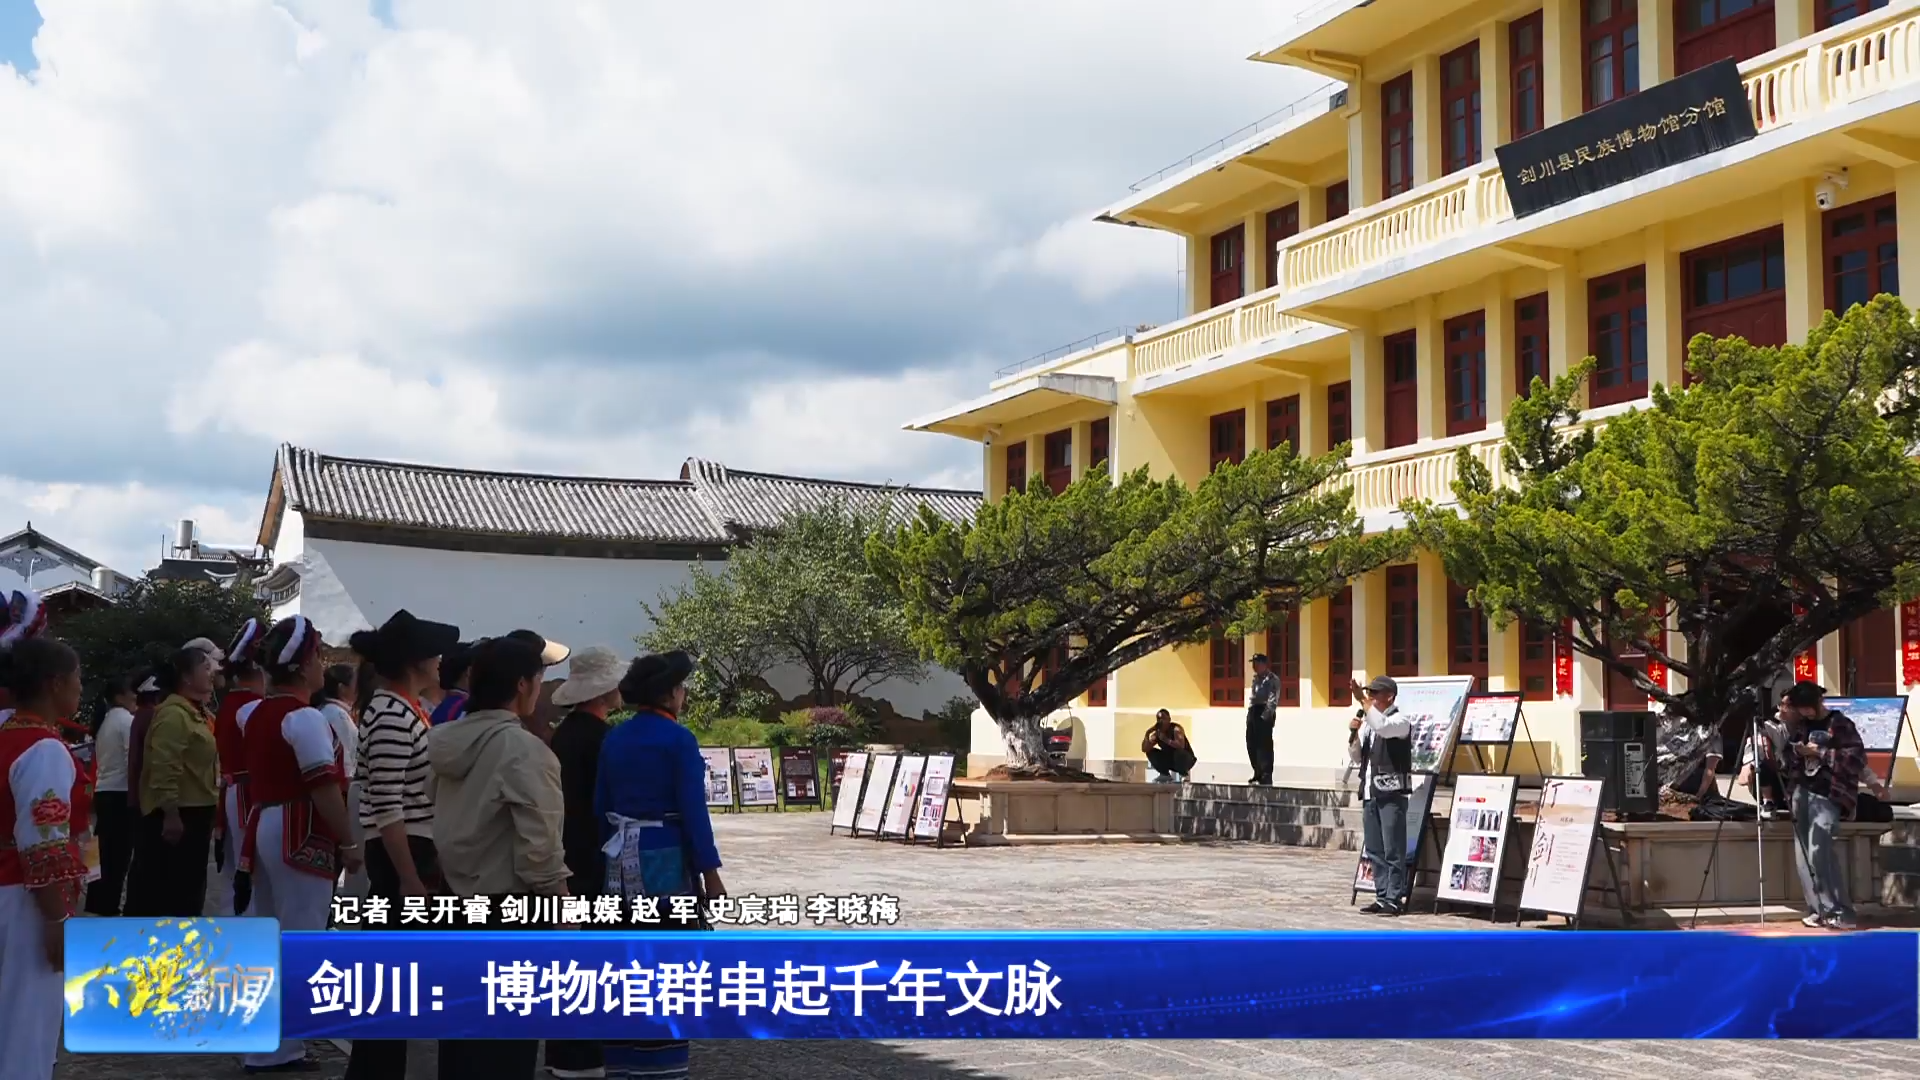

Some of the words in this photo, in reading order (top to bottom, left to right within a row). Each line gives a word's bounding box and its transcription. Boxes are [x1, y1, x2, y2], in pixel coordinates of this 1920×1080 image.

[1517, 96, 1726, 185] 剑川县民族博物馆分馆
